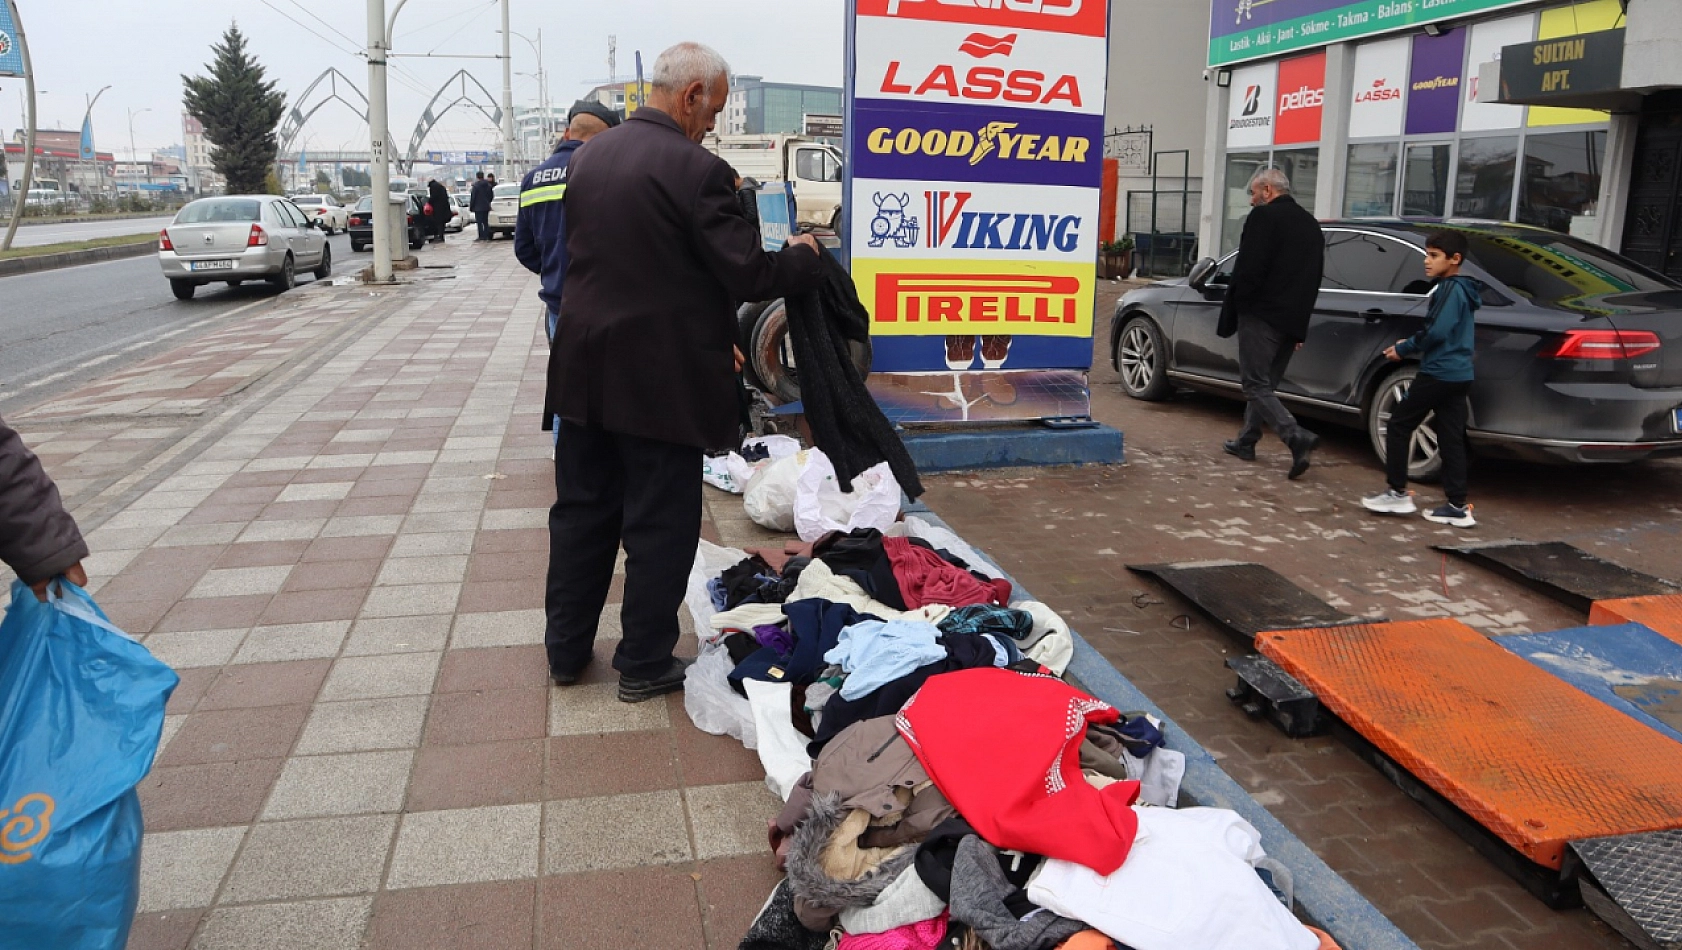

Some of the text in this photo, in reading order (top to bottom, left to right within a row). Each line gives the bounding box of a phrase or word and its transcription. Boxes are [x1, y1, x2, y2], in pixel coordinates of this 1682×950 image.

[1230, 36, 1250, 52] Lastik
[1277, 26, 1294, 44] Jant
[1300, 20, 1329, 37] Sökme
[1337, 10, 1369, 28] Takma
[1378, 1, 1413, 19] Balans
[1533, 39, 1586, 66] SULTAN
[880, 61, 1082, 107] LASSA
[1412, 76, 1459, 90] GOODYEAR
[1541, 69, 1570, 91] APT.
[1278, 86, 1324, 116] petlas
[1354, 88, 1401, 103] LASSA
[1230, 116, 1271, 129] BRIDGESTONE
[867, 122, 1090, 166] GOODYEAR
[924, 190, 1082, 252] VIKING
[875, 272, 1080, 323] PIRELLI
